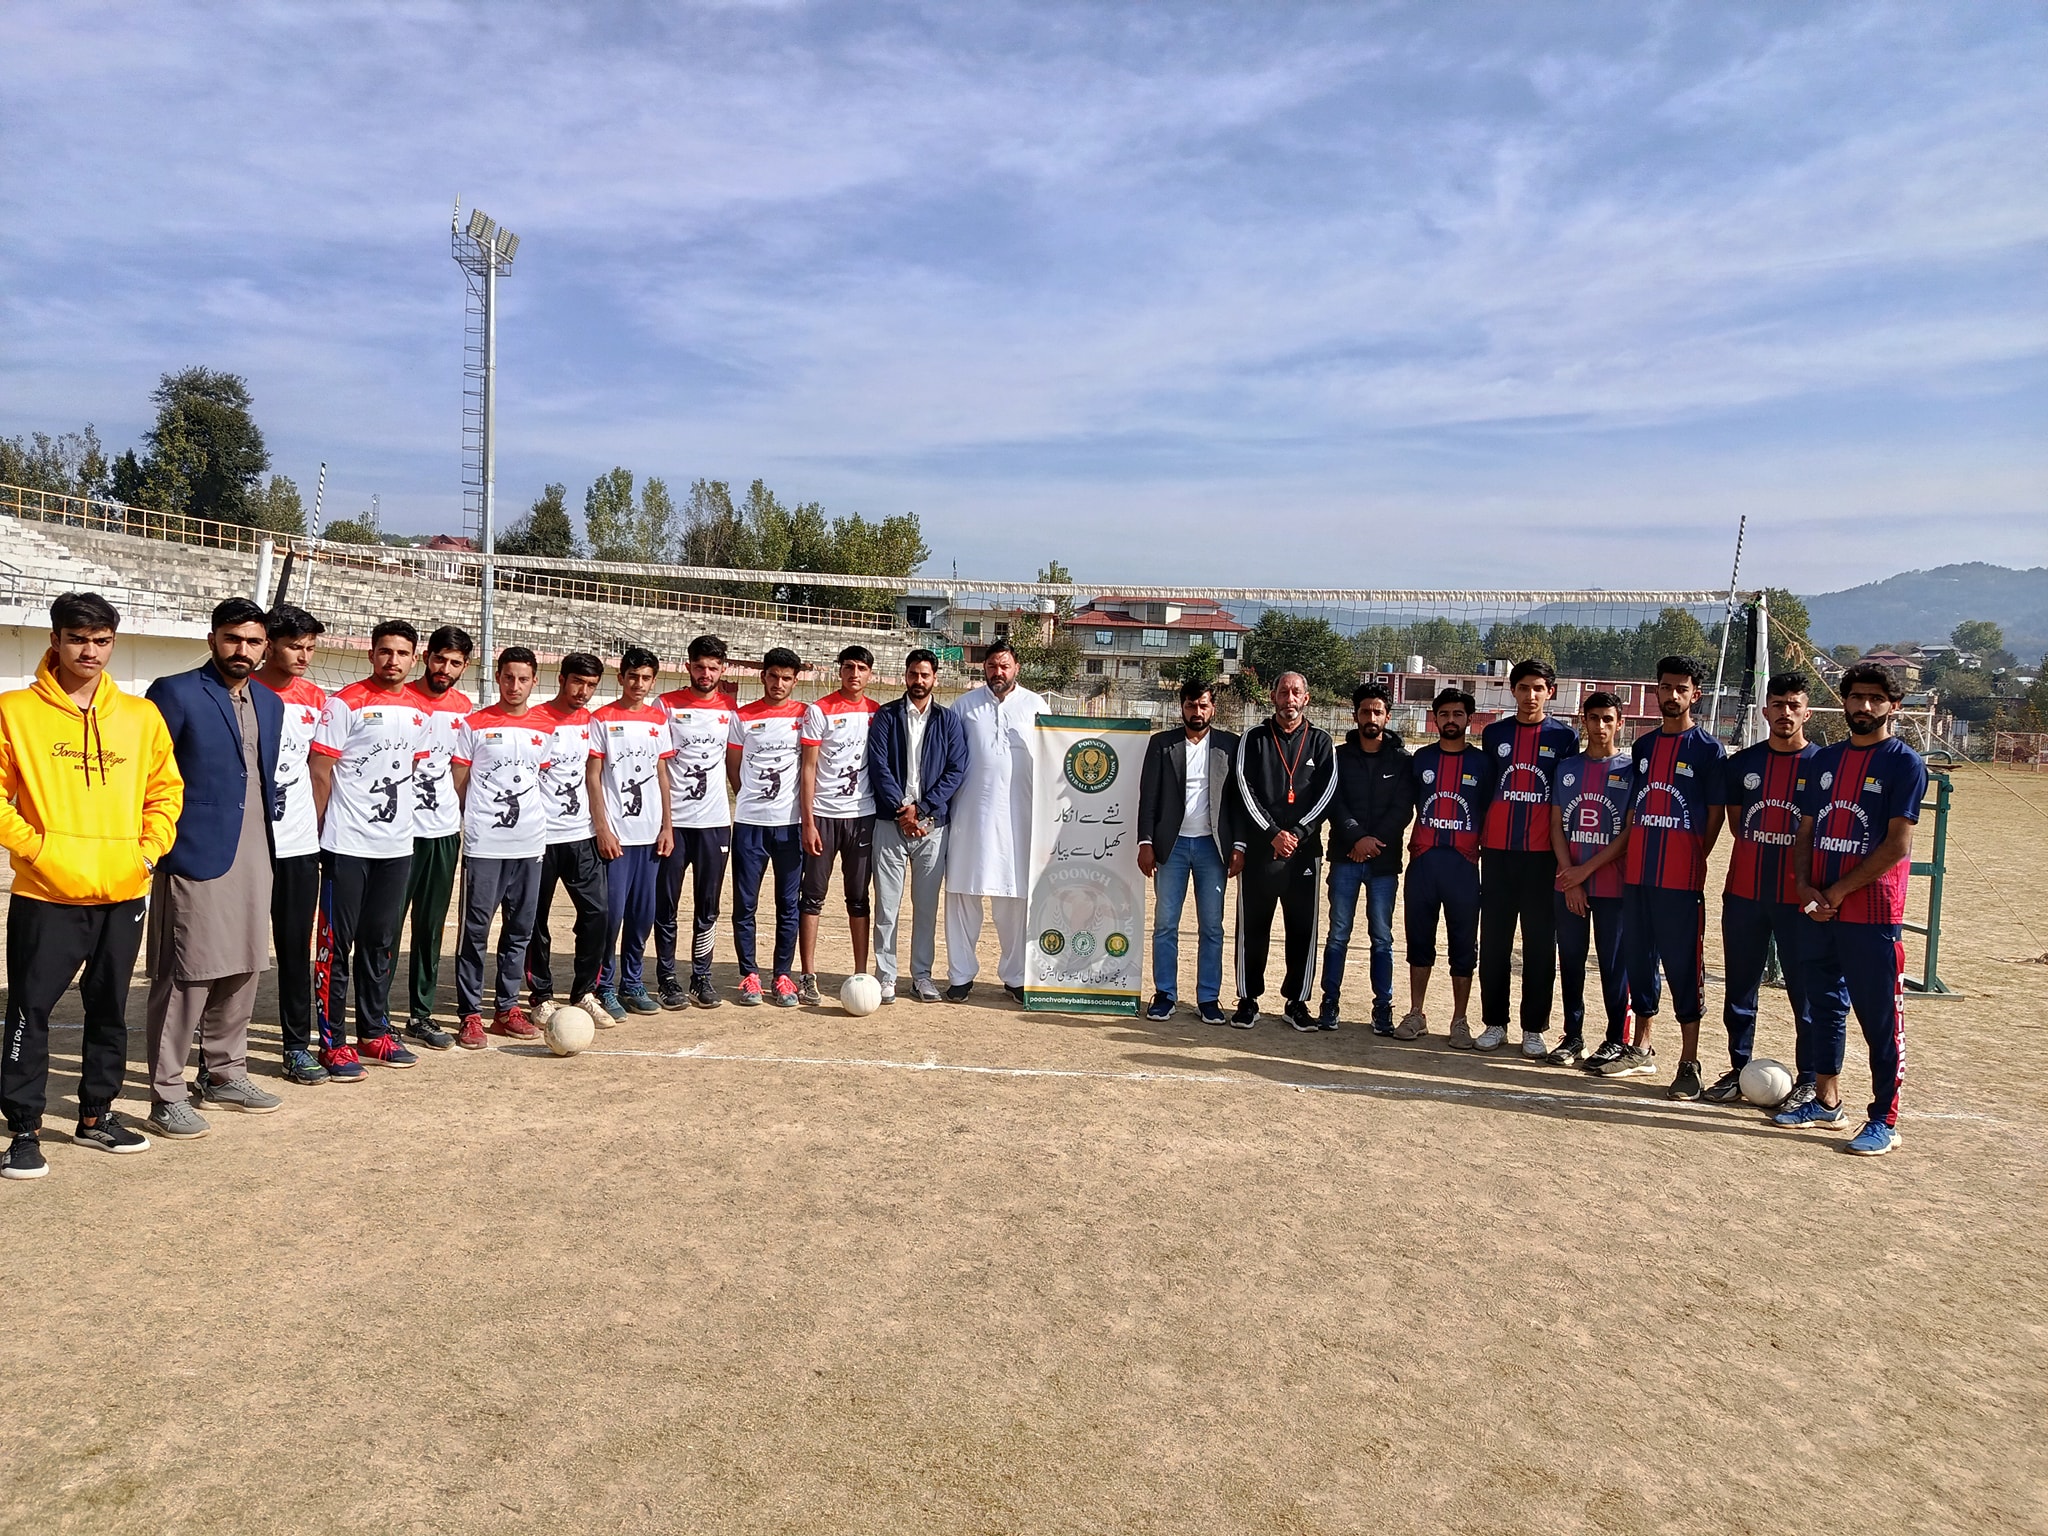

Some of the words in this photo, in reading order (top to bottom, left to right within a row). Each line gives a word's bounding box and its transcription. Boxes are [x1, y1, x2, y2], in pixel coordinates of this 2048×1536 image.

[1077, 740, 1107, 749] POONCH
[1438, 791, 1470, 814] VOLLEYBALL
[1503, 790, 1543, 803] PACHIOT
[1650, 781, 1688, 809] VOLLEYBALL
[1054, 805, 1079, 823] انکار
[1079, 814, 1101, 823] سے
[1102, 803, 1124, 824] نشے
[1579, 808, 1599, 827] B
[1583, 792, 1619, 816] VOLLEYBALL
[1612, 816, 1622, 835] CLUB
[1765, 798, 1802, 821] VOLLEYBA
[1429, 817, 1463, 830] PACHIOT
[1640, 814, 1681, 829] PACHIOT
[1093, 831, 1127, 860] کھیل
[1570, 830, 1610, 845] AIRGALI
[1753, 830, 1796, 846] PACHIOT
[1820, 836, 1861, 854] PACHIOT
[1050, 840, 1070, 861] پیار
[1070, 846, 1092, 856] سے
[1048, 867, 1112, 887] POONCH
[1029, 996, 1136, 1007] poonchvolleyballassociation.com
[14, 1029, 22, 1042] DO
[10, 1041, 21, 1062] JUST
